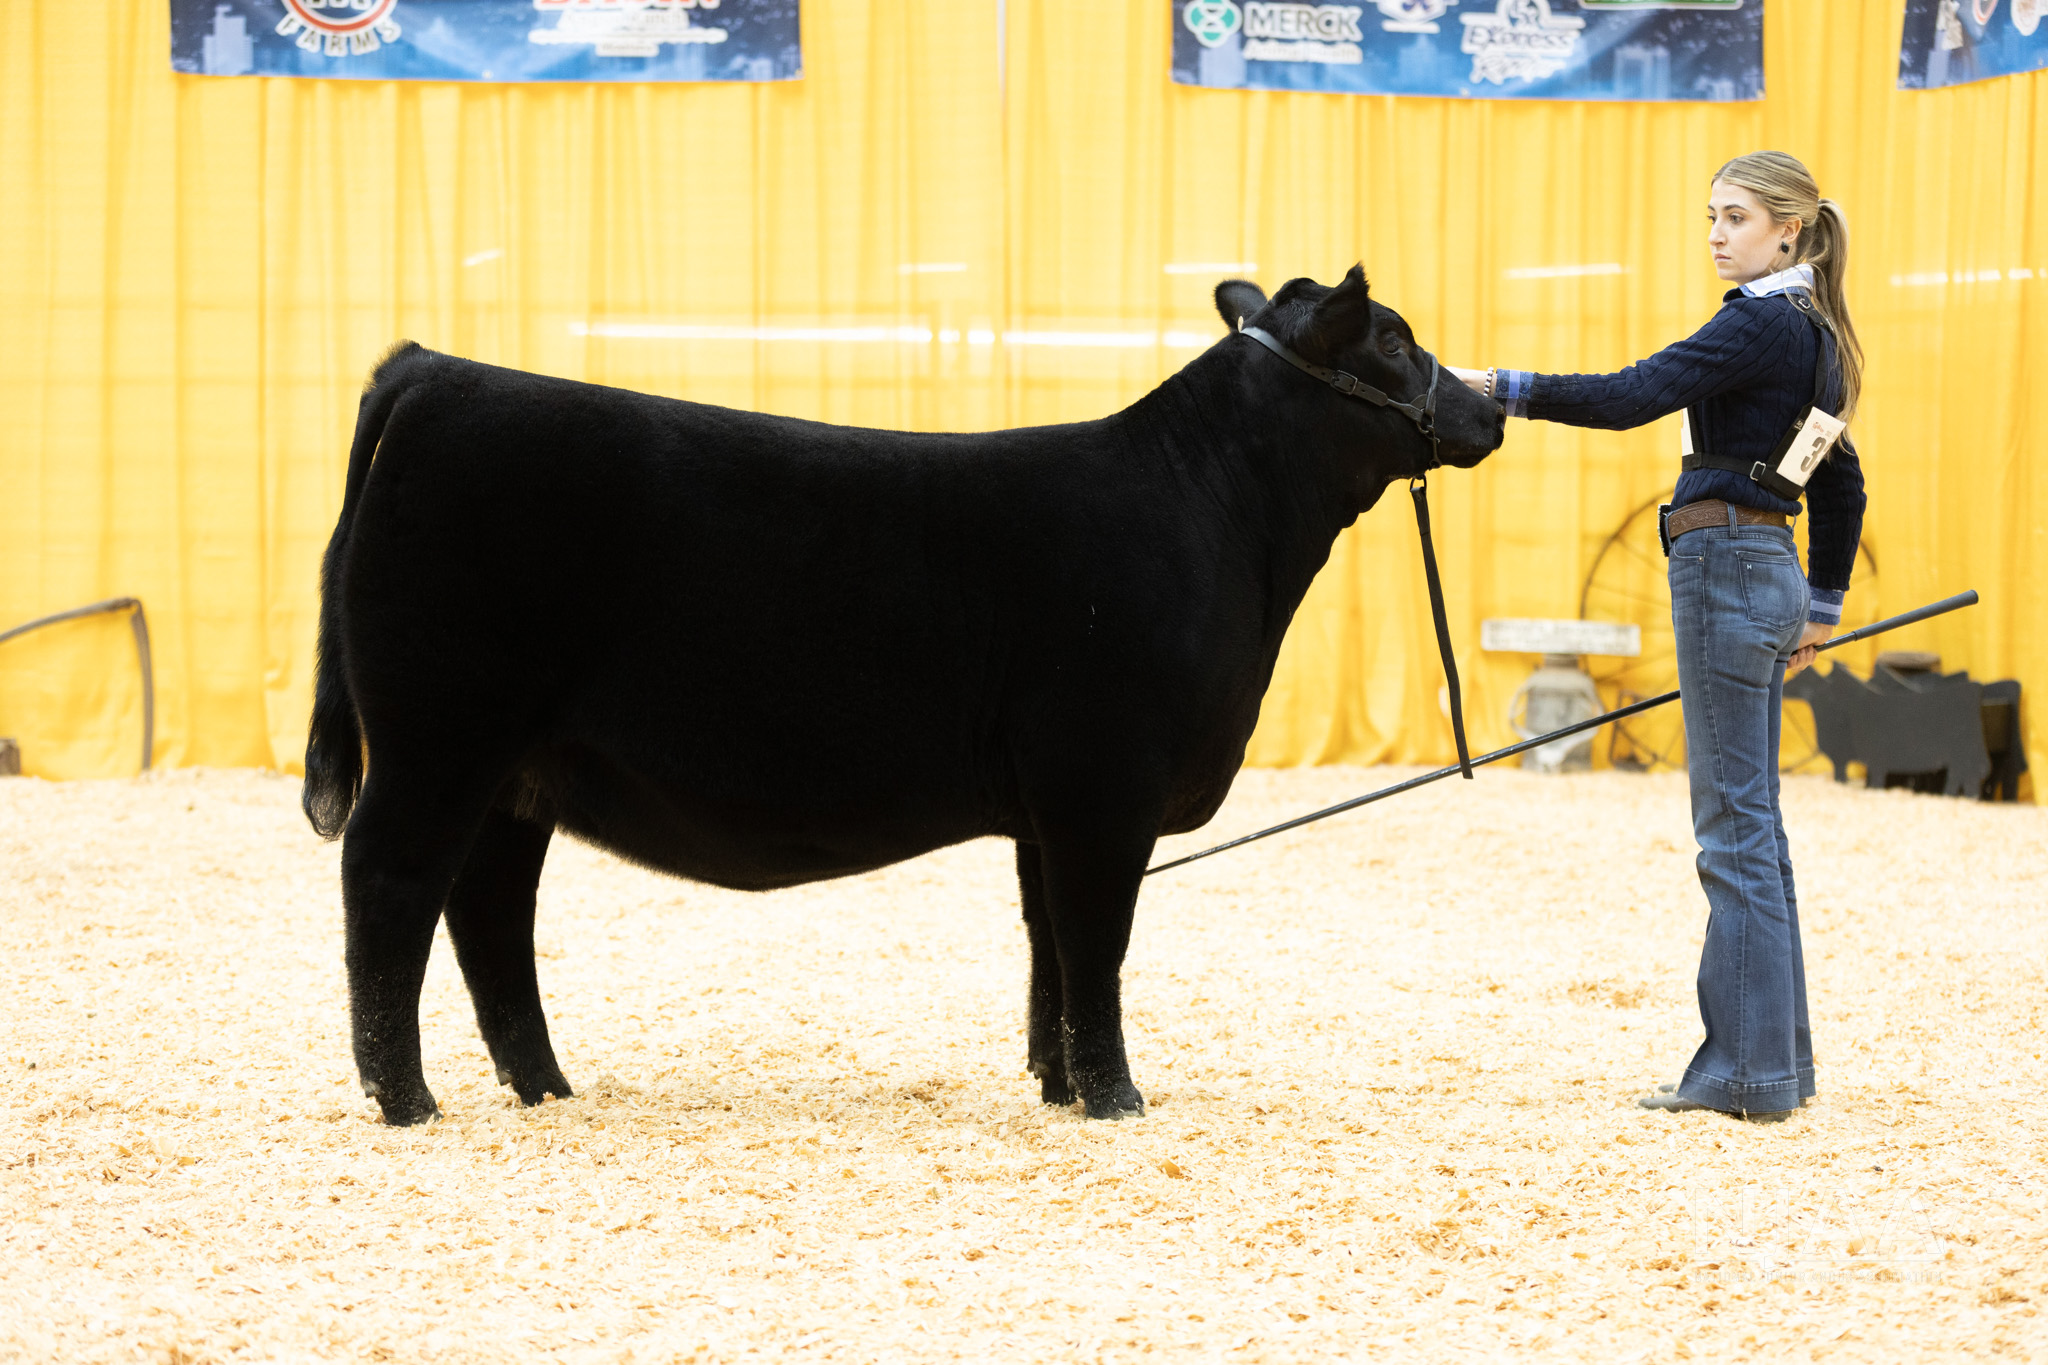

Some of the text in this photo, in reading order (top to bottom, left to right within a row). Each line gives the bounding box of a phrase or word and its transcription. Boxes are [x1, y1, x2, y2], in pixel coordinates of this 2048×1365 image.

[277, 14, 400, 56] FARMS
[1245, 4, 1360, 38] MERCK
[1800, 437, 1832, 473] 3
